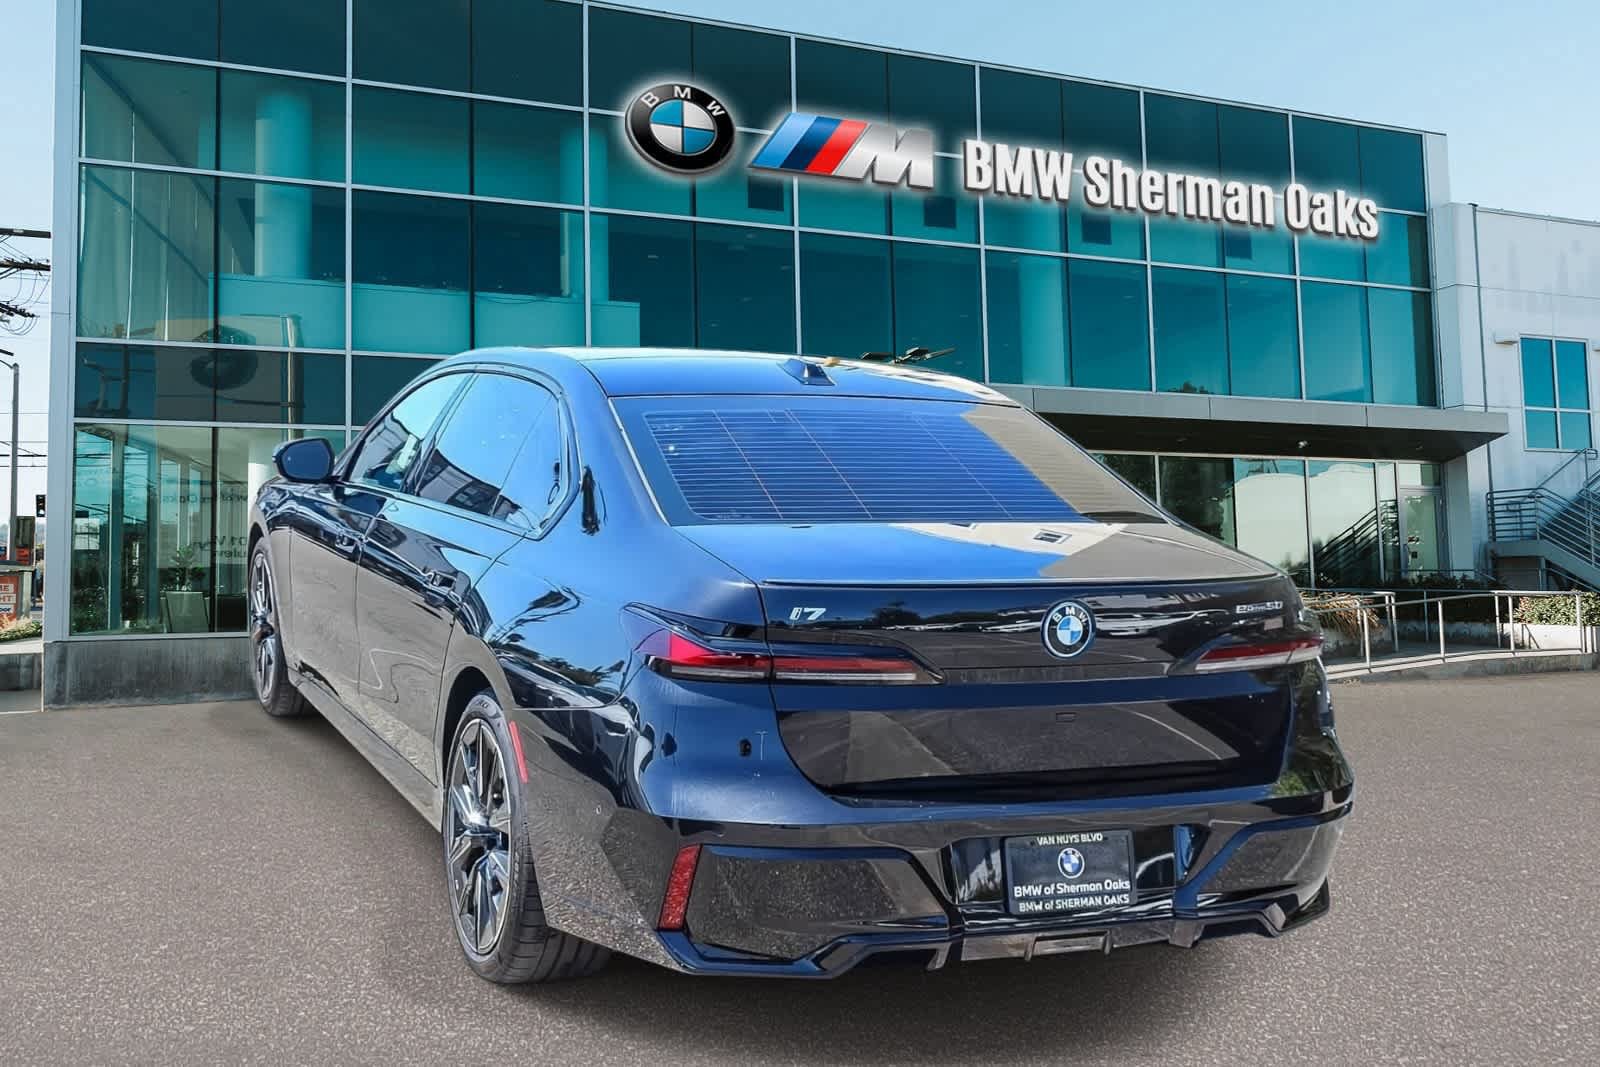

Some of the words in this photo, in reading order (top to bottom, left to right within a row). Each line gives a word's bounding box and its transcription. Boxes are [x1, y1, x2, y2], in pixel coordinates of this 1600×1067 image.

[640, 85, 725, 117] BMW
[964, 138, 1073, 201] BMW
[1083, 155, 1275, 227] Sherman
[1284, 182, 1380, 241] Oaks
[1052, 606, 1088, 623] BMW
[1037, 835, 1055, 846] VAN
[1056, 833, 1079, 845] NUYS
[1014, 884, 1042, 897] BMW
[1044, 883, 1055, 895] of
[1056, 881, 1102, 894] Sherman
[1104, 879, 1130, 890] Oaks
[1019, 901, 1043, 912] BMW
[1044, 900, 1054, 910] of
[1056, 895, 1103, 909] SHERMAN
[1104, 893, 1129, 905] OAKS
